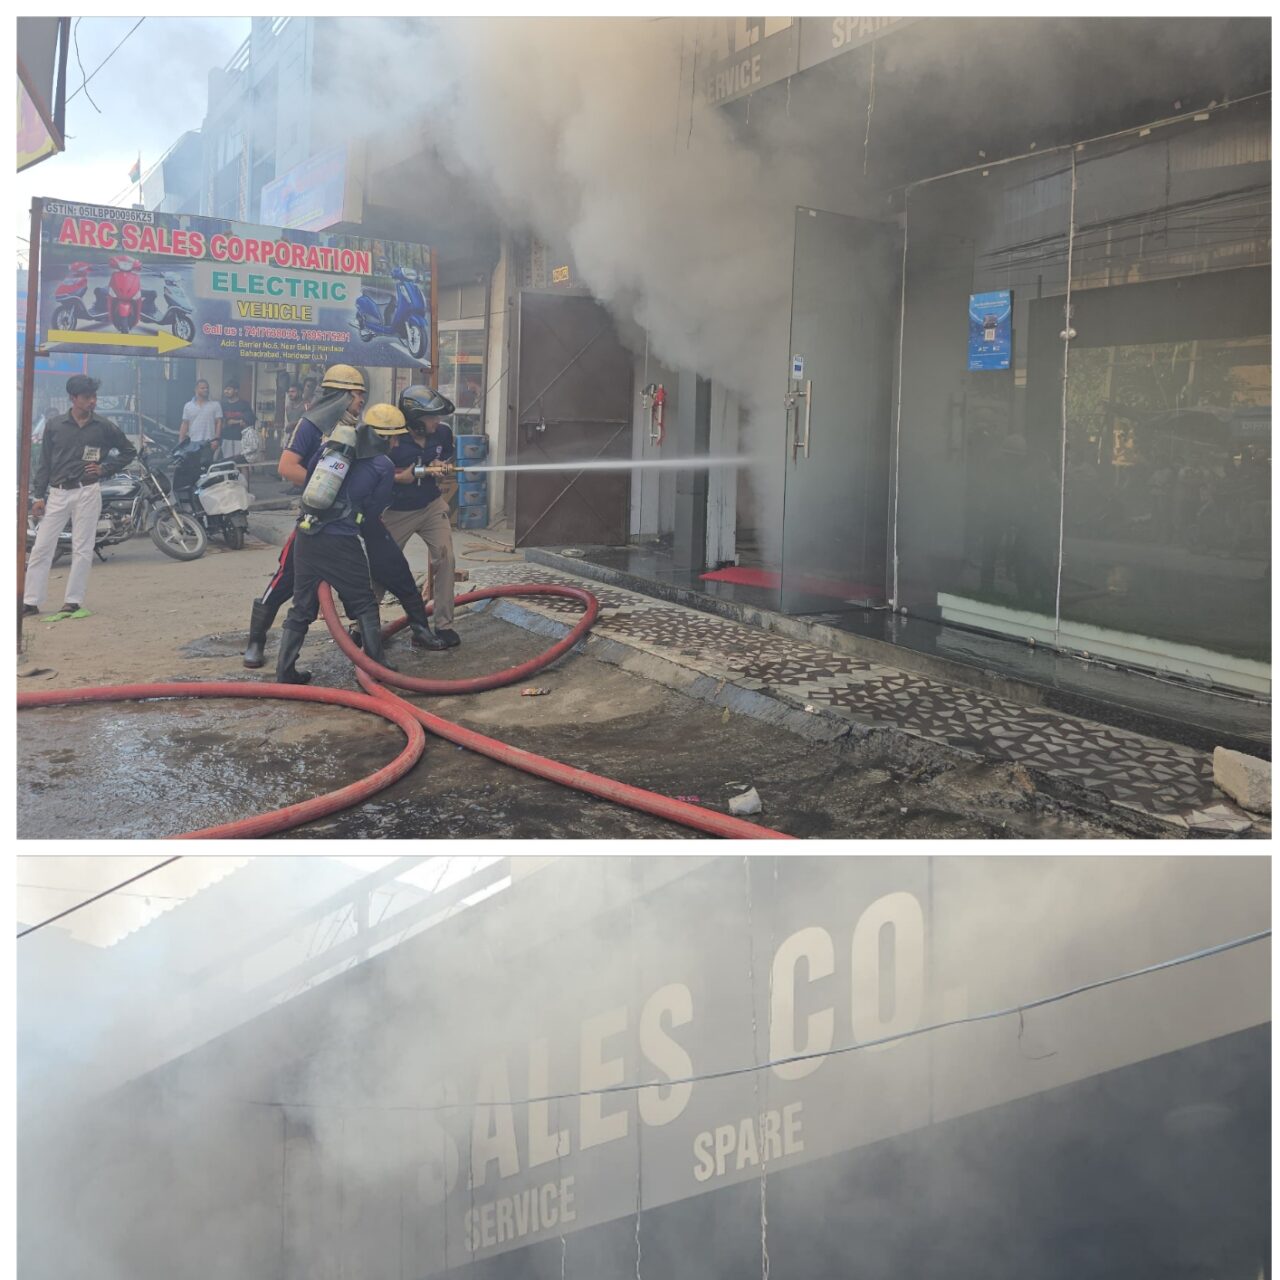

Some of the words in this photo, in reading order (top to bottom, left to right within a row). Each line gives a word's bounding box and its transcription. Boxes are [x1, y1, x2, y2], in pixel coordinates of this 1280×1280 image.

[46, 203, 77, 215] GSTIN:
[59, 217, 117, 249] ARC
[122, 223, 205, 260] SALES
[210, 233, 372, 276] CORPORATION
[212, 271, 347, 301] ELECTRIC
[237, 300, 312, 322] VEHICLE
[203, 323, 222, 336] Call
[224, 326, 237, 337] us
[419, 982, 693, 1202] SALES
[464, 1175, 576, 1254] SERVICE
[693, 1101, 805, 1183] SPARE
